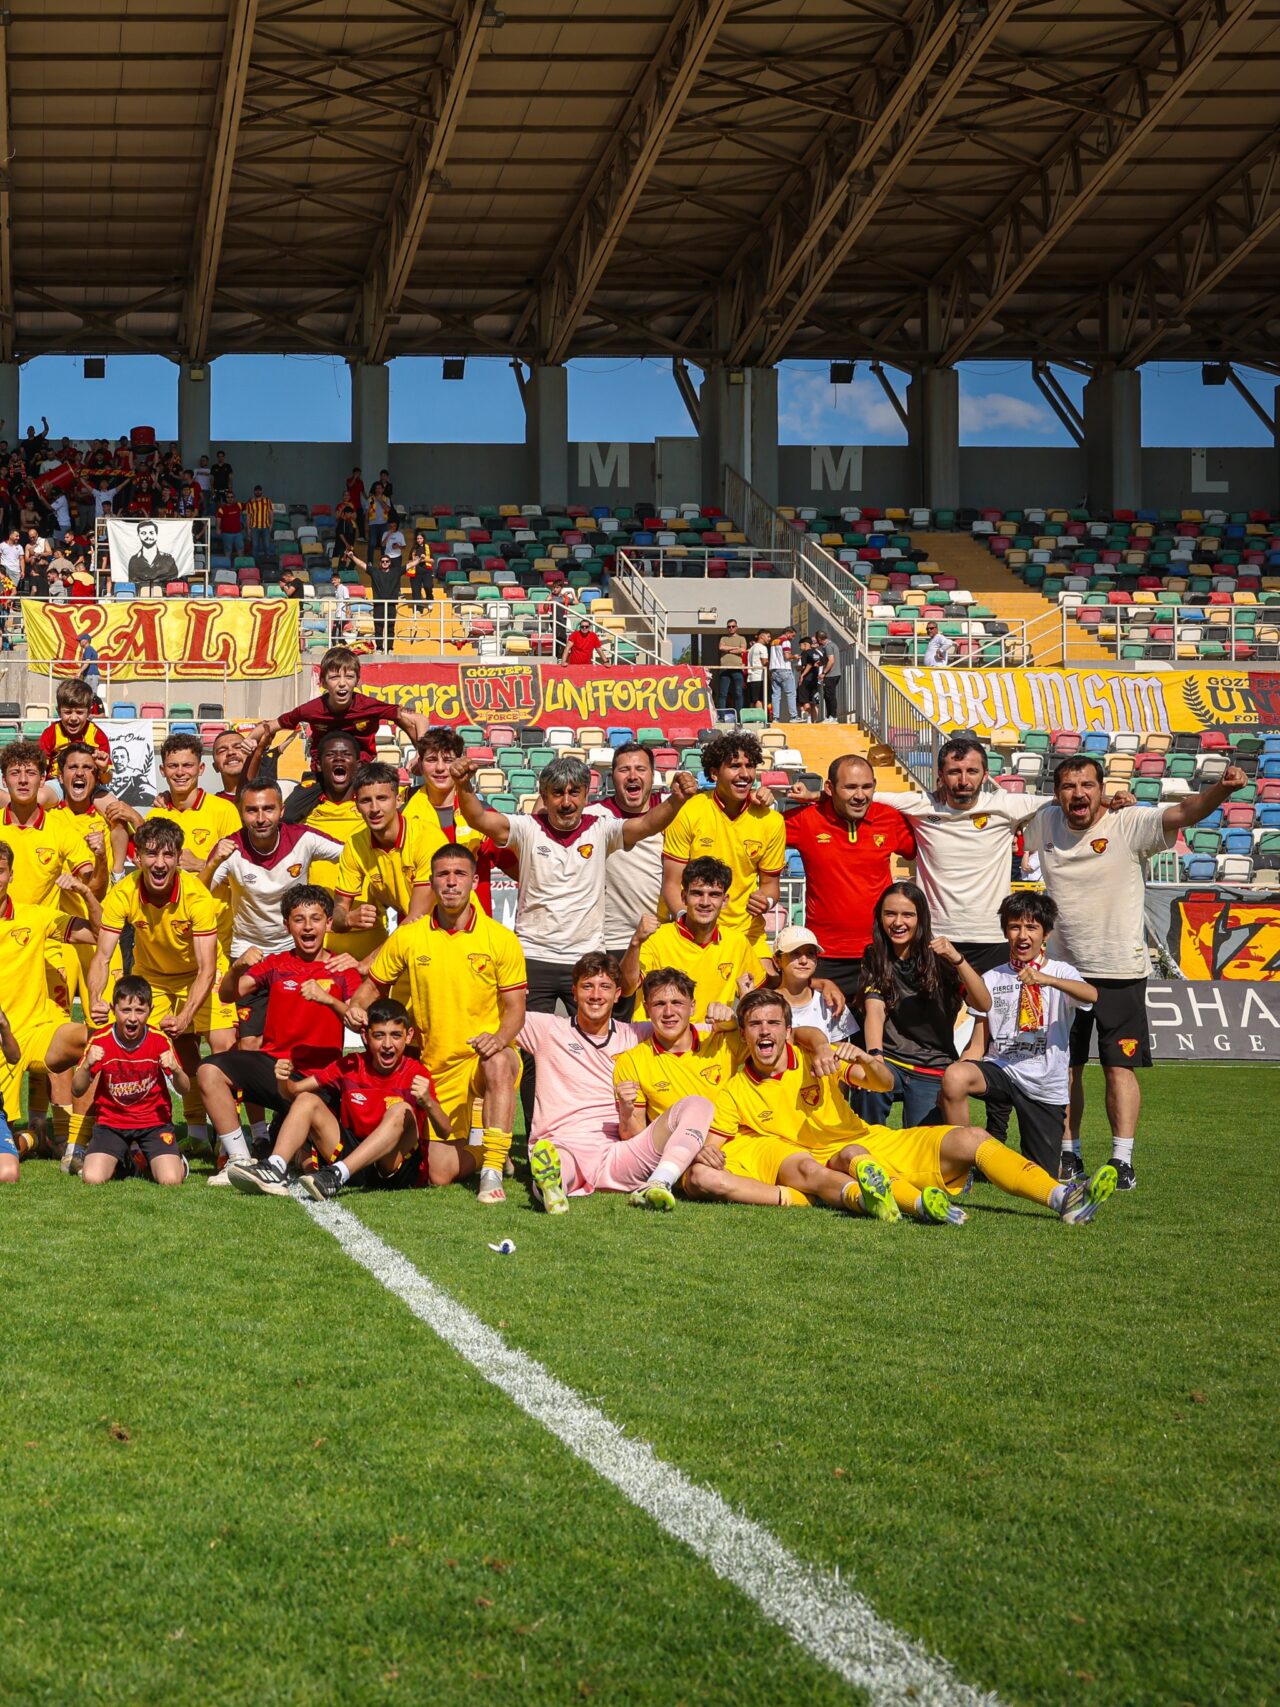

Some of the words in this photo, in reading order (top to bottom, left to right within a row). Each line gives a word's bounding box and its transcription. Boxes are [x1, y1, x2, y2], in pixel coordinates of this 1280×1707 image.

[577, 442, 630, 488] M
[810, 446, 863, 491] M
[1191, 448, 1229, 493] L
[42, 601, 288, 677] YALI
[466, 665, 532, 677] GÖZTEPE
[465, 675, 536, 709] UNI
[1206, 686, 1280, 714] UN
[487, 712, 519, 721] FORCE
